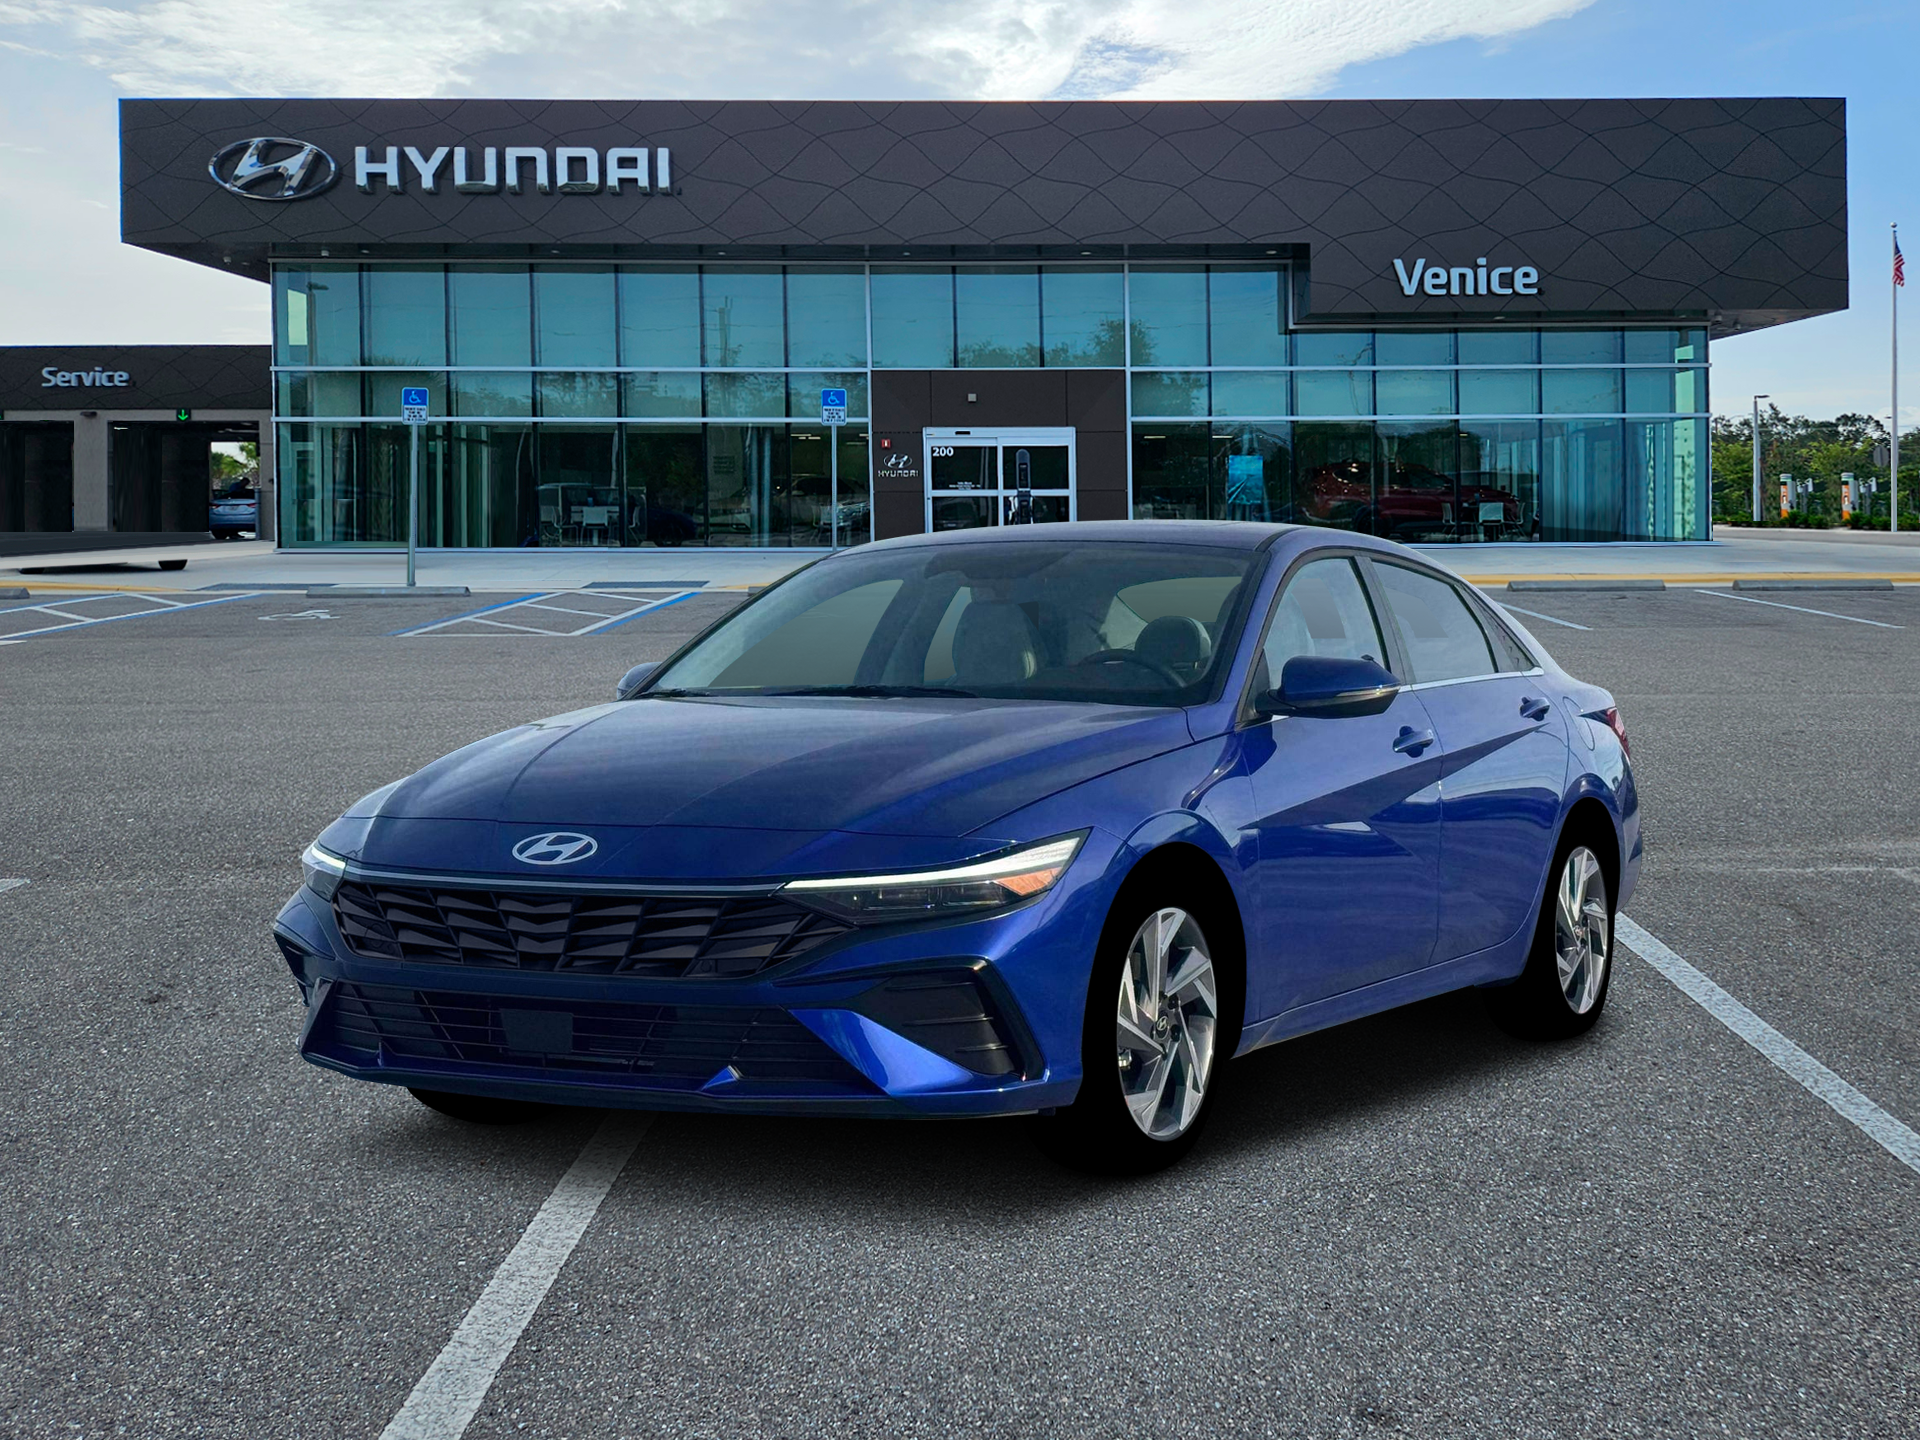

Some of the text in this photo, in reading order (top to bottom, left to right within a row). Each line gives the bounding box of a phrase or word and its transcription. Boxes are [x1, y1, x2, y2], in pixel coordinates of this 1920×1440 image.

[354, 146, 670, 193] HYUNDAI
[1393, 257, 1539, 296] Venice
[41, 366, 130, 388] Service
[932, 447, 955, 457] 200
